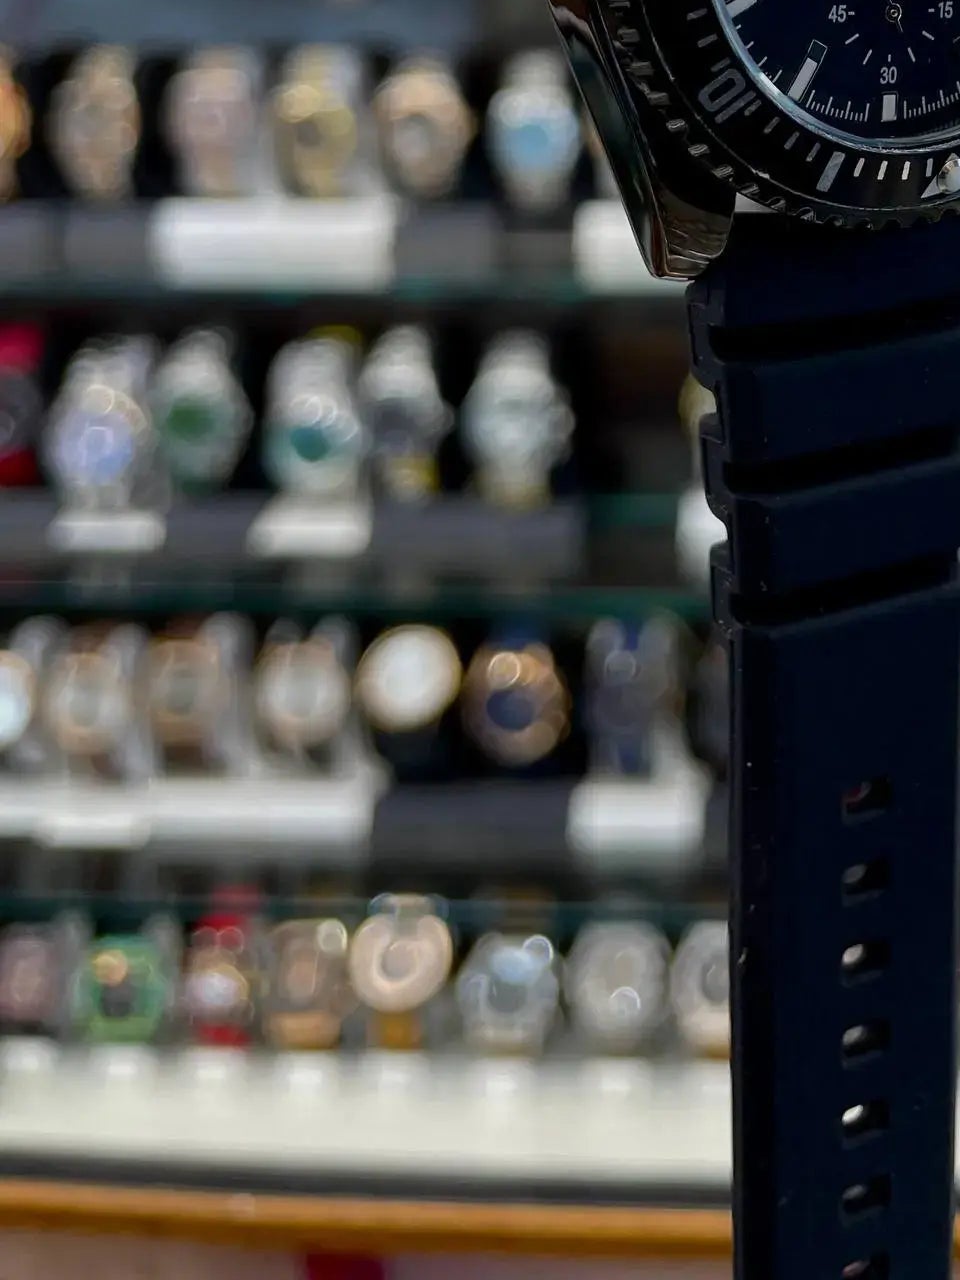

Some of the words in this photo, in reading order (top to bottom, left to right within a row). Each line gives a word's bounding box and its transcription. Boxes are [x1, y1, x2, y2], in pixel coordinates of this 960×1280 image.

[828, 5, 847, 23] 45
[938, 1, 953, 19] 15
[880, 66, 897, 84] 30
[698, 68, 757, 124] 10
